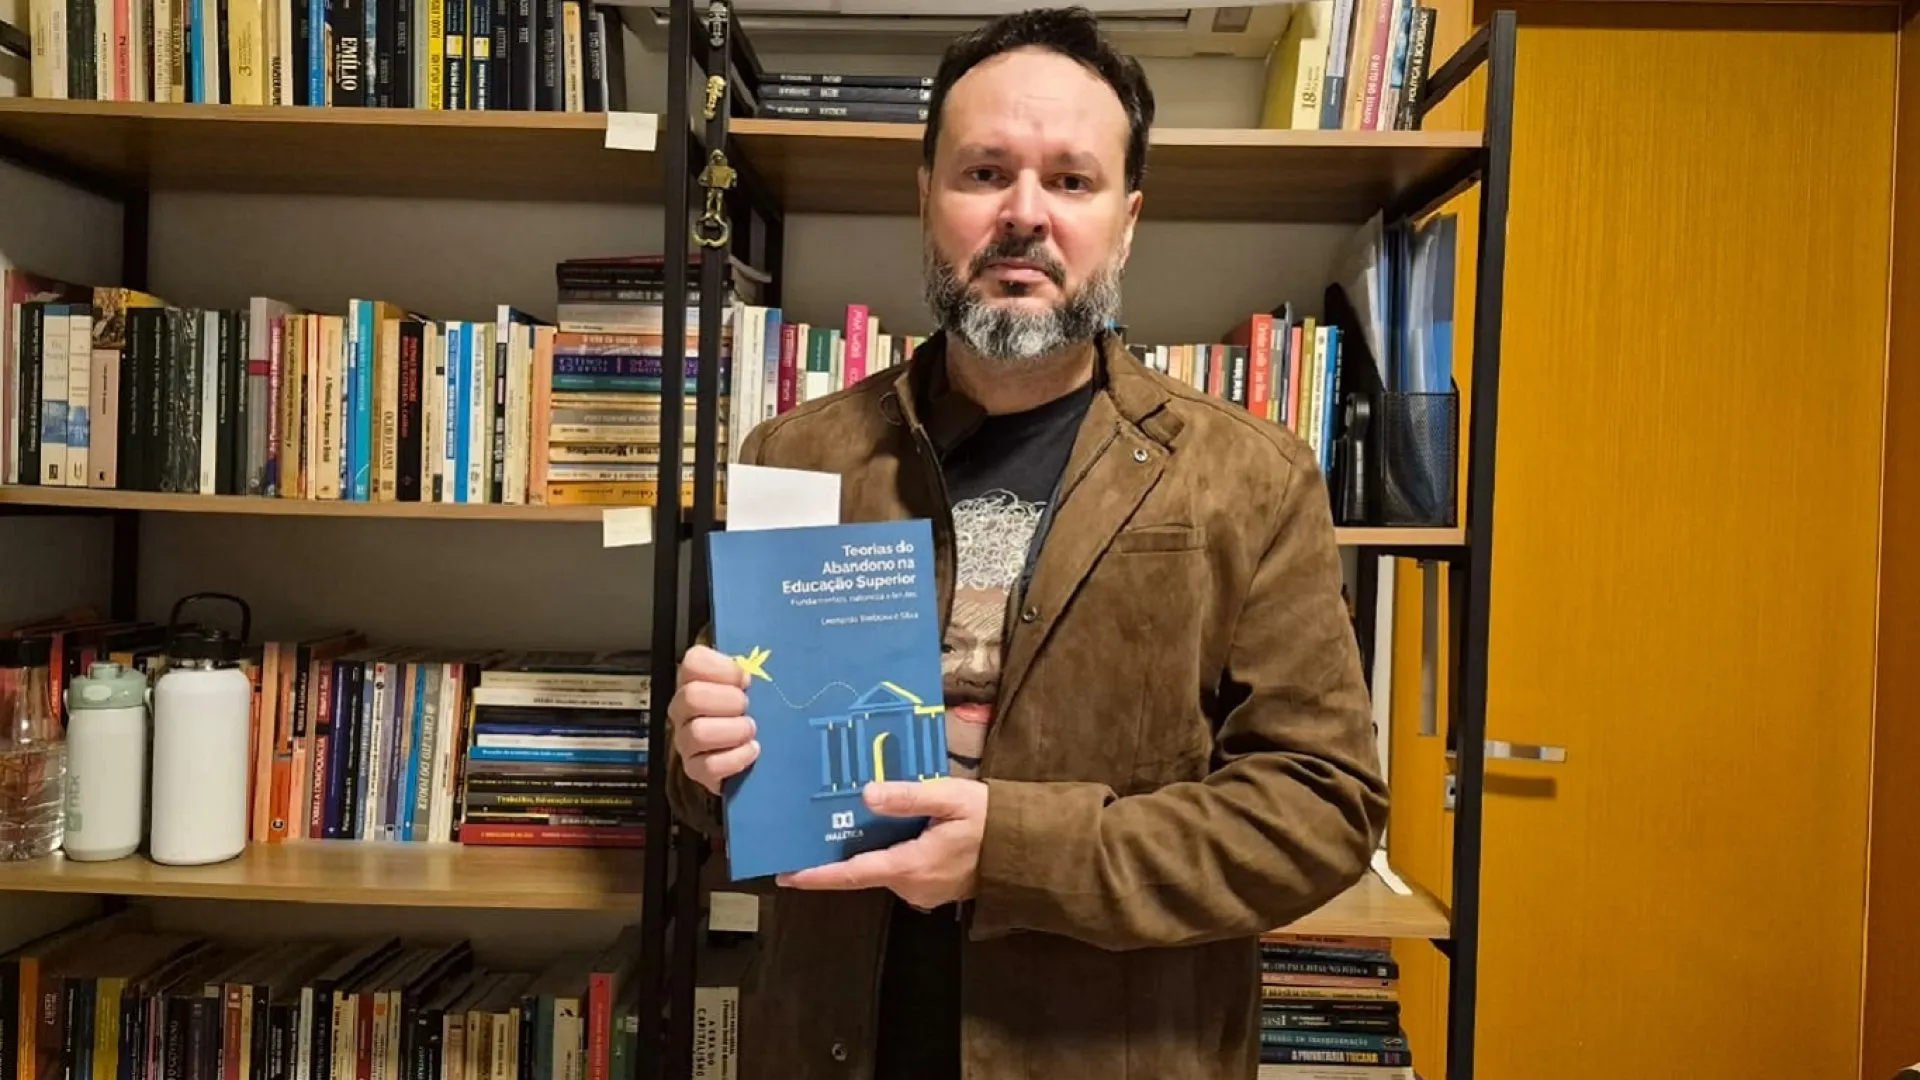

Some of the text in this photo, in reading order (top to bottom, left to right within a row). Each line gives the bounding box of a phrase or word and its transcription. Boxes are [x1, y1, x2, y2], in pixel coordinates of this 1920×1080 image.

[340, 37, 361, 91] EMÍLIO
[841, 540, 914, 558] Teorias do
[823, 558, 915, 575] Abandono na
[782, 573, 917, 595] Educação Superior
[695, 1008, 706, 1077] CAPITALISMO
